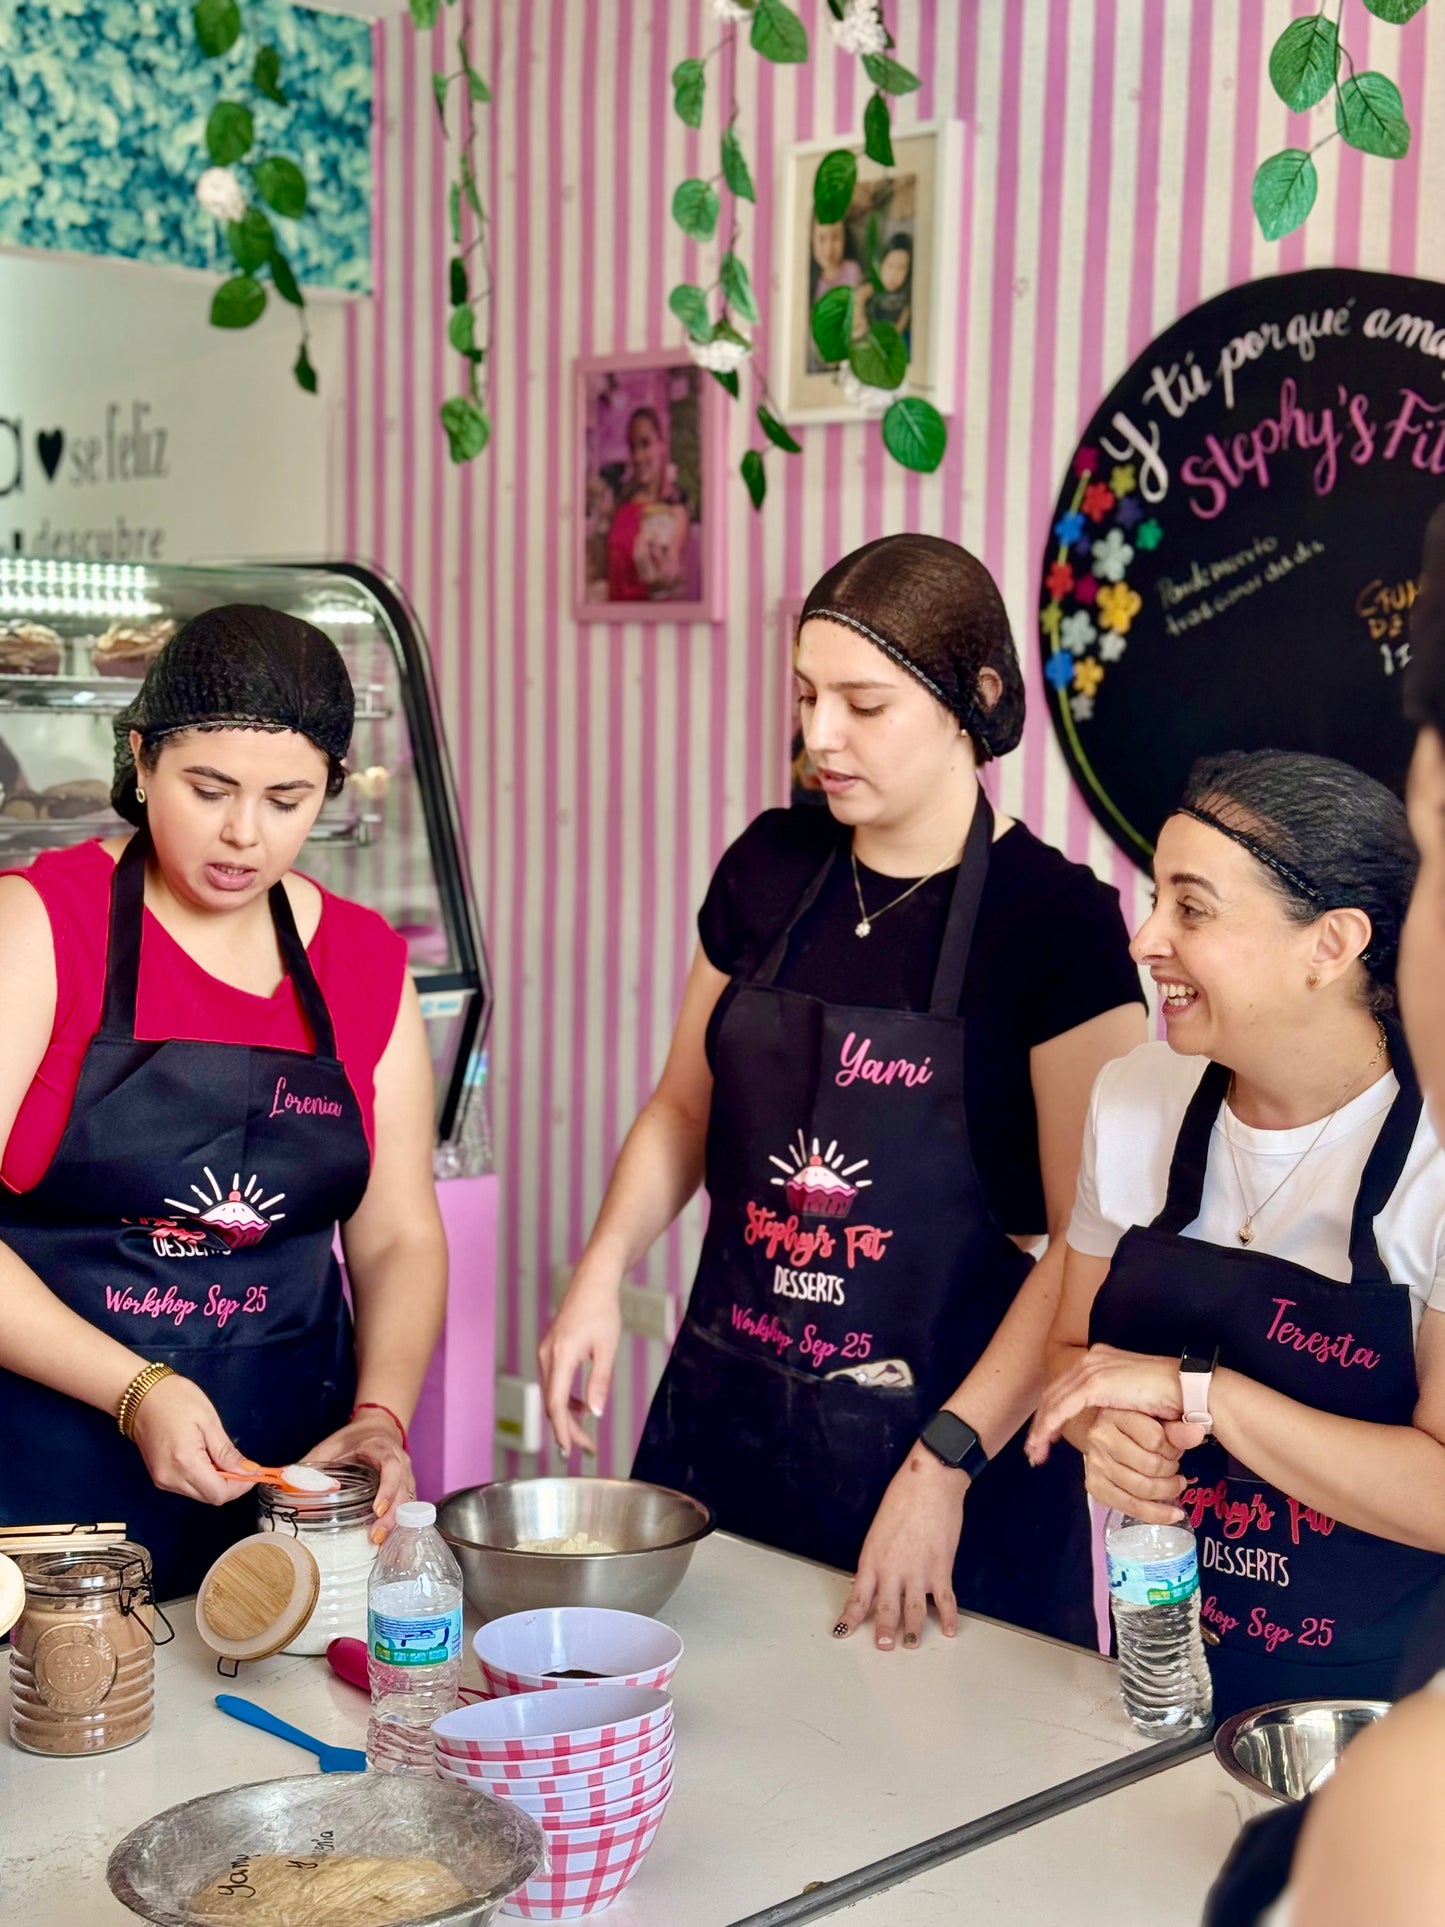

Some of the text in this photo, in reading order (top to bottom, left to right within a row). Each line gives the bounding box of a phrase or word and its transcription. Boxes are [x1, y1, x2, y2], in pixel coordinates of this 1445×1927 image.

[1143, 351, 1211, 418] tú
[1180, 377, 1376, 519] Stephy's
[835, 1032, 933, 1087] Yami
[269, 1077, 342, 1118] Lorenia
[106, 1284, 268, 1328] Workshop Sep 25
[773, 1264, 845, 1306] DESSERTS
[732, 1304, 873, 1368] Workshop Sep 25
[1266, 1298, 1380, 1369] Teresita
[1203, 1537, 1290, 1587] DESSERTS
[1247, 1607, 1293, 1652] Sep
[1298, 1617, 1336, 1647] 25
